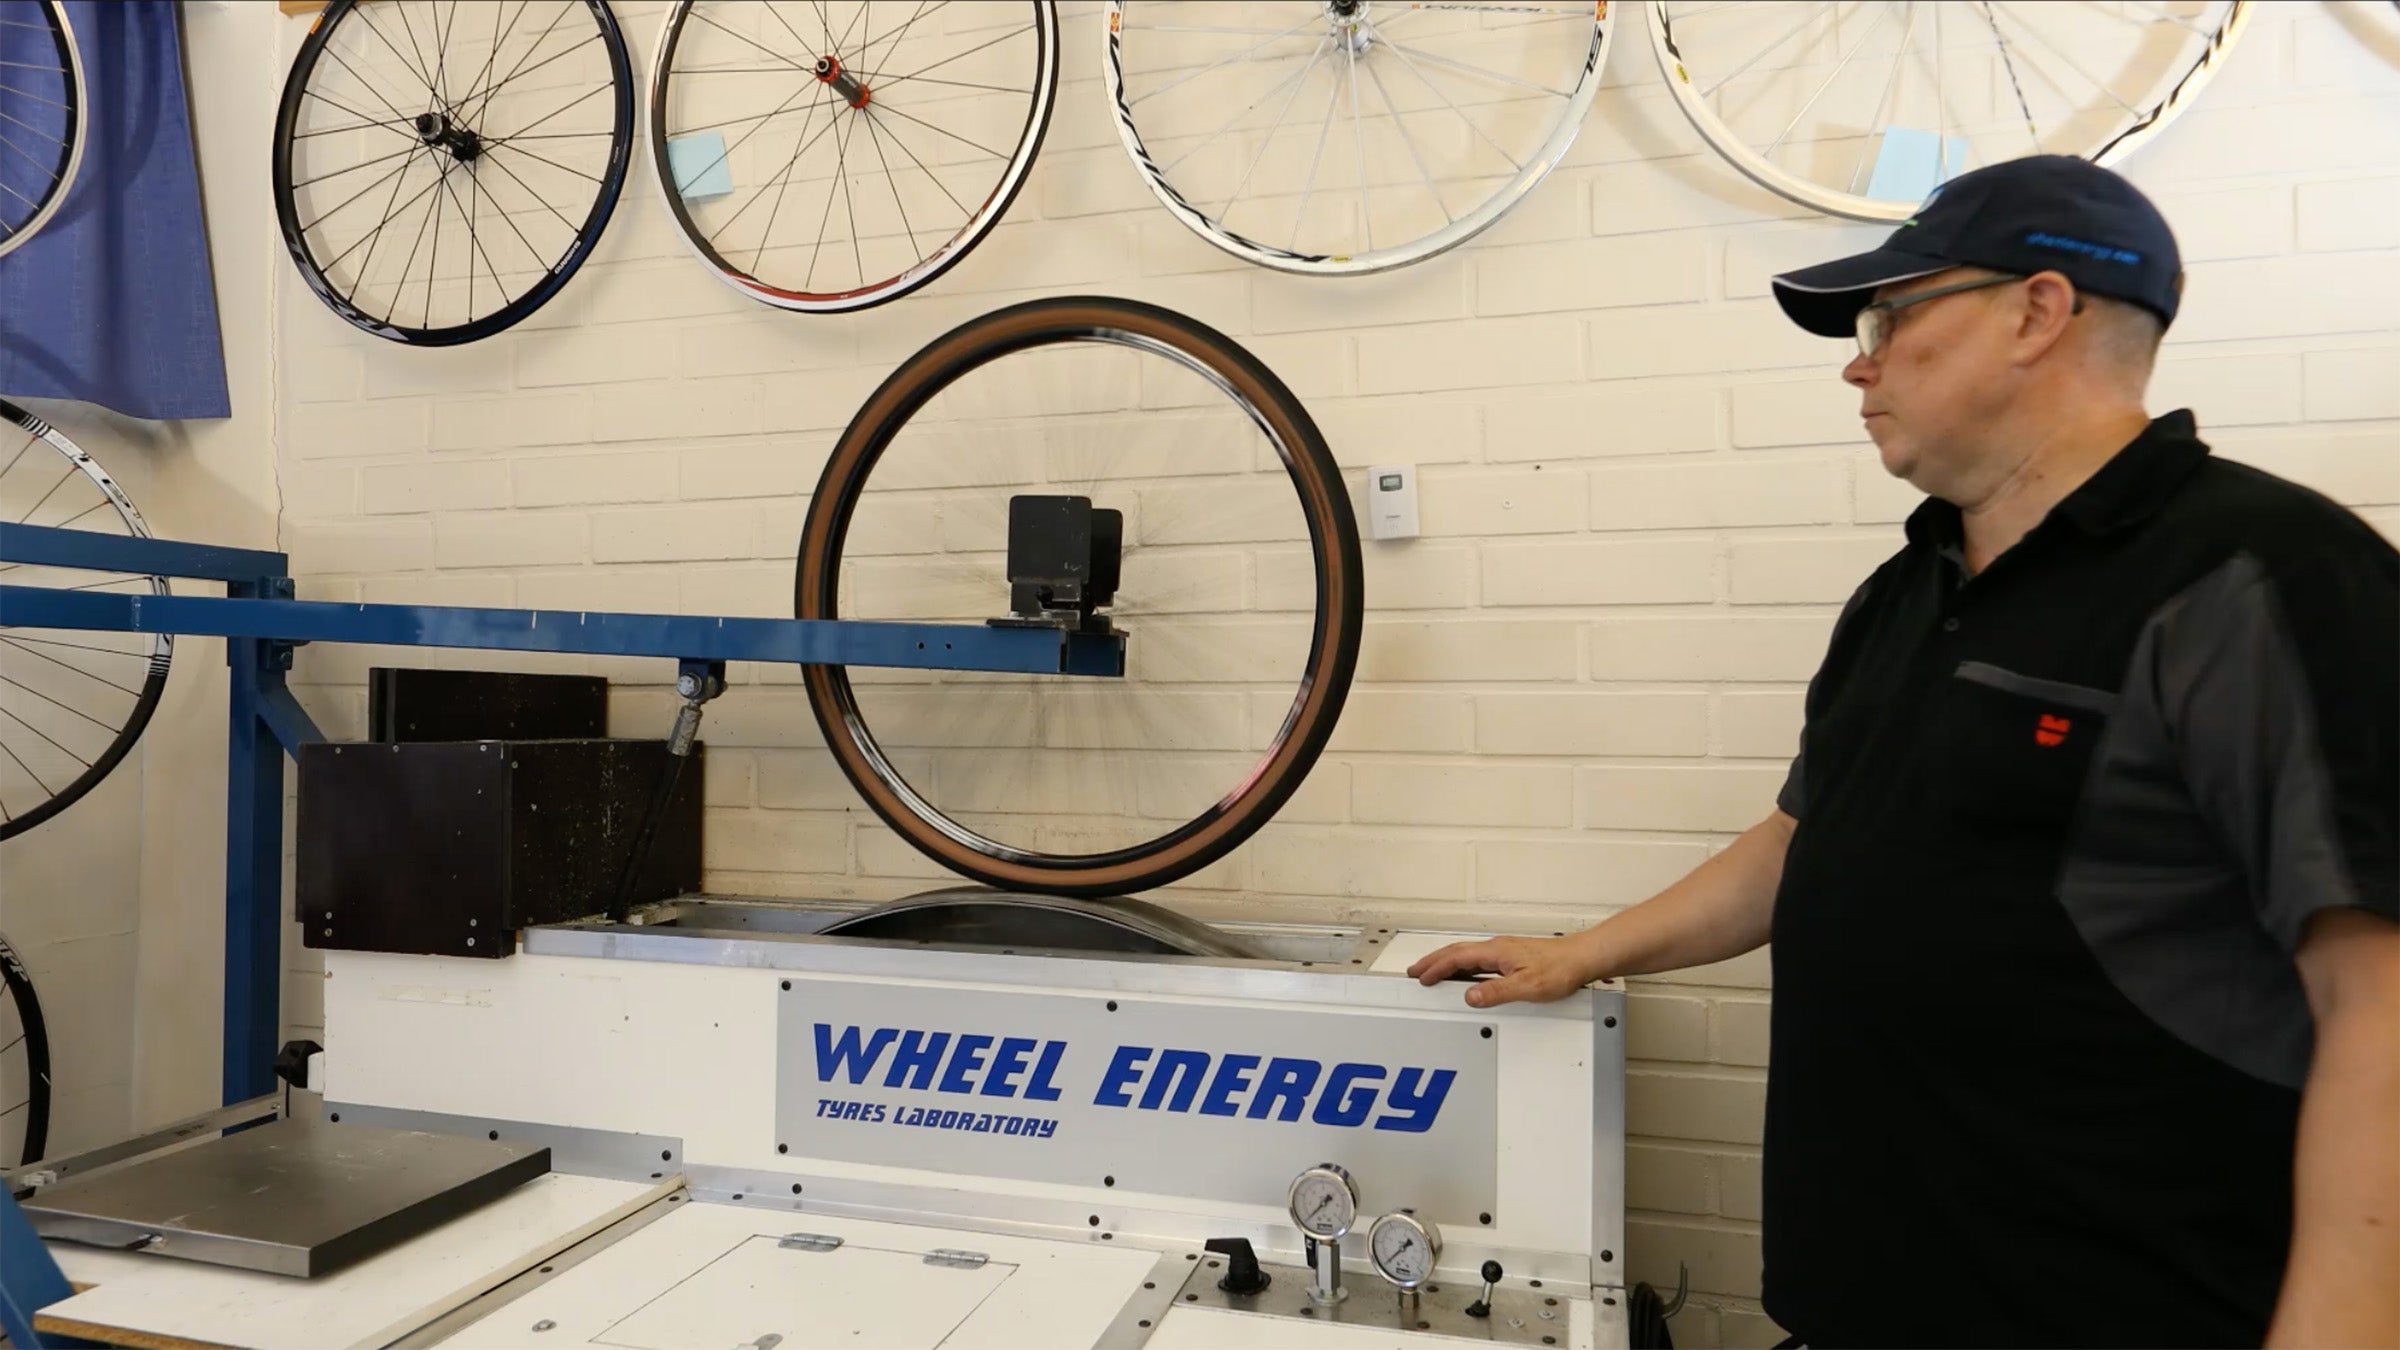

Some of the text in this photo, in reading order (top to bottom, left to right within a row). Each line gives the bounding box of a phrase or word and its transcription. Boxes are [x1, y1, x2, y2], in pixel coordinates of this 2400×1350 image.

[813, 1023, 1458, 1133] WHEEL ENERGY
[816, 1099, 1059, 1139] TYRES LABORATORY
